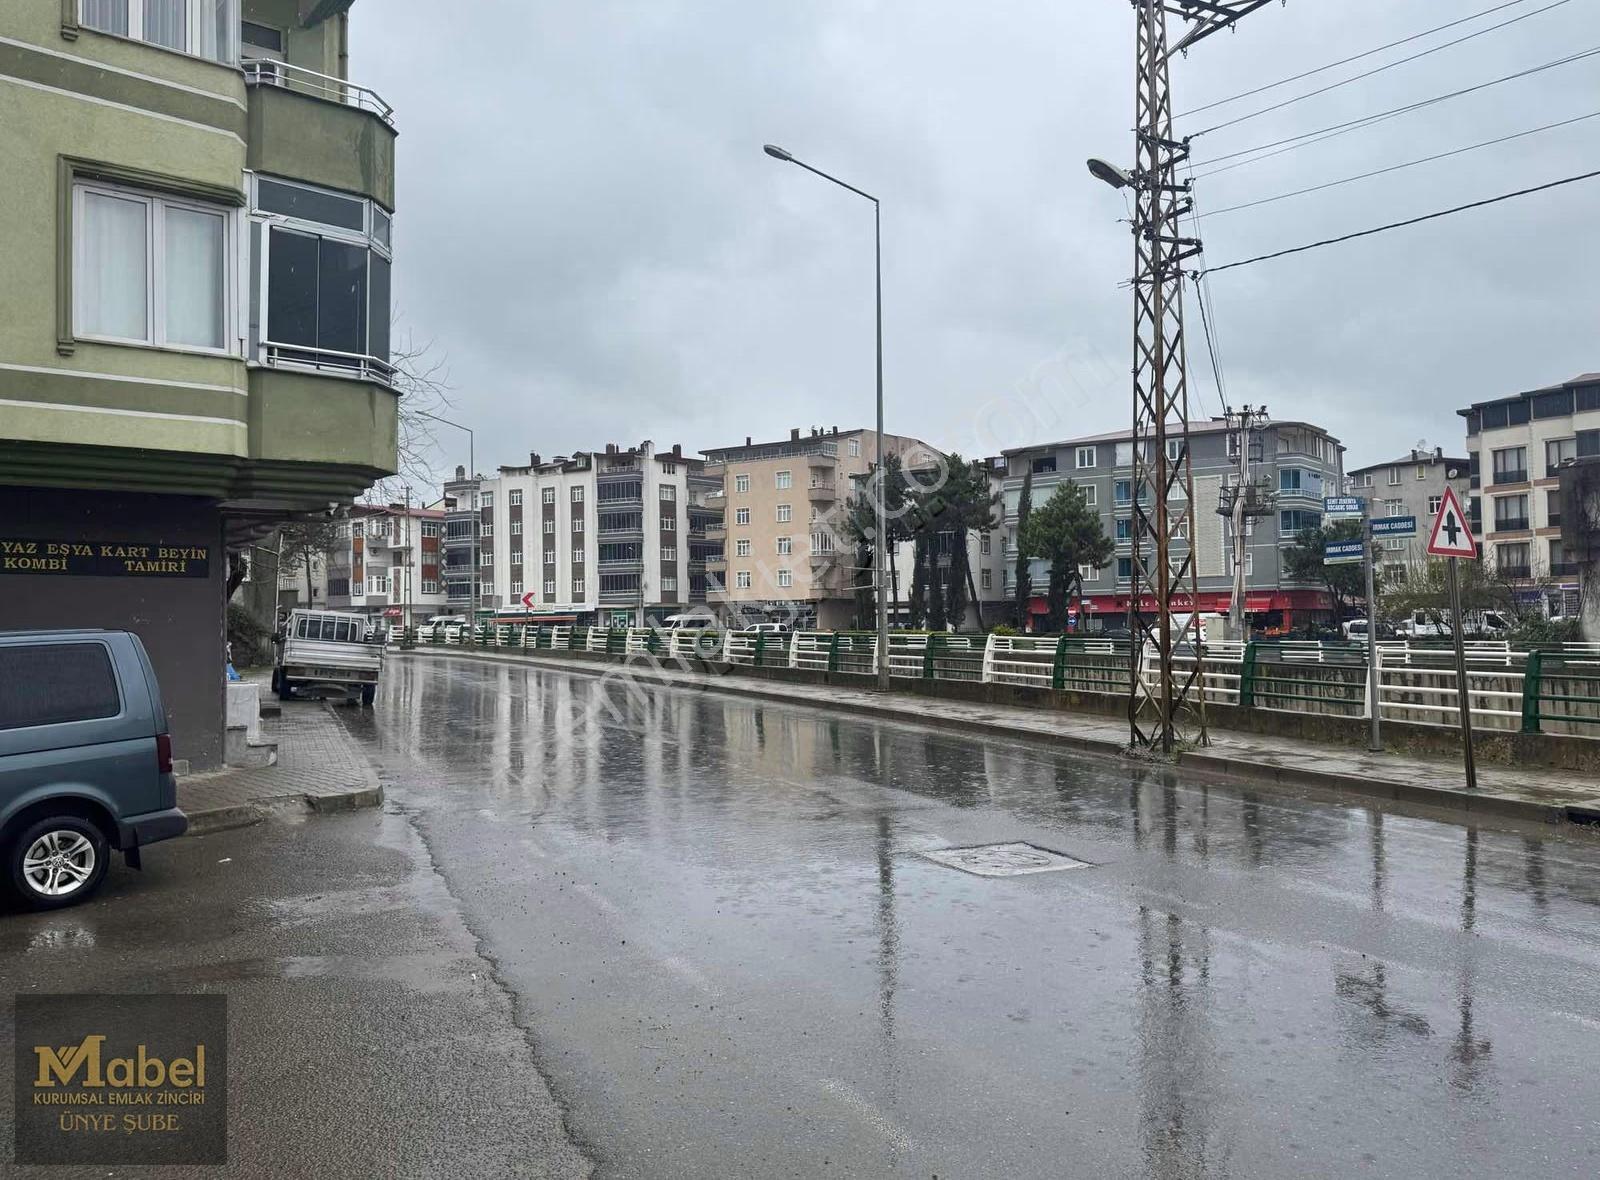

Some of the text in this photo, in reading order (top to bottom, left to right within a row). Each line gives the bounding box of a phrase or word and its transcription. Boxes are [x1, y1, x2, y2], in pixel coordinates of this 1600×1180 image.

[47, 543, 93, 556] EŞYA
[101, 545, 149, 558] KART
[158, 547, 207, 560] BEYİN
[4, 557, 186, 573] KOMBİ TAMİRİ
